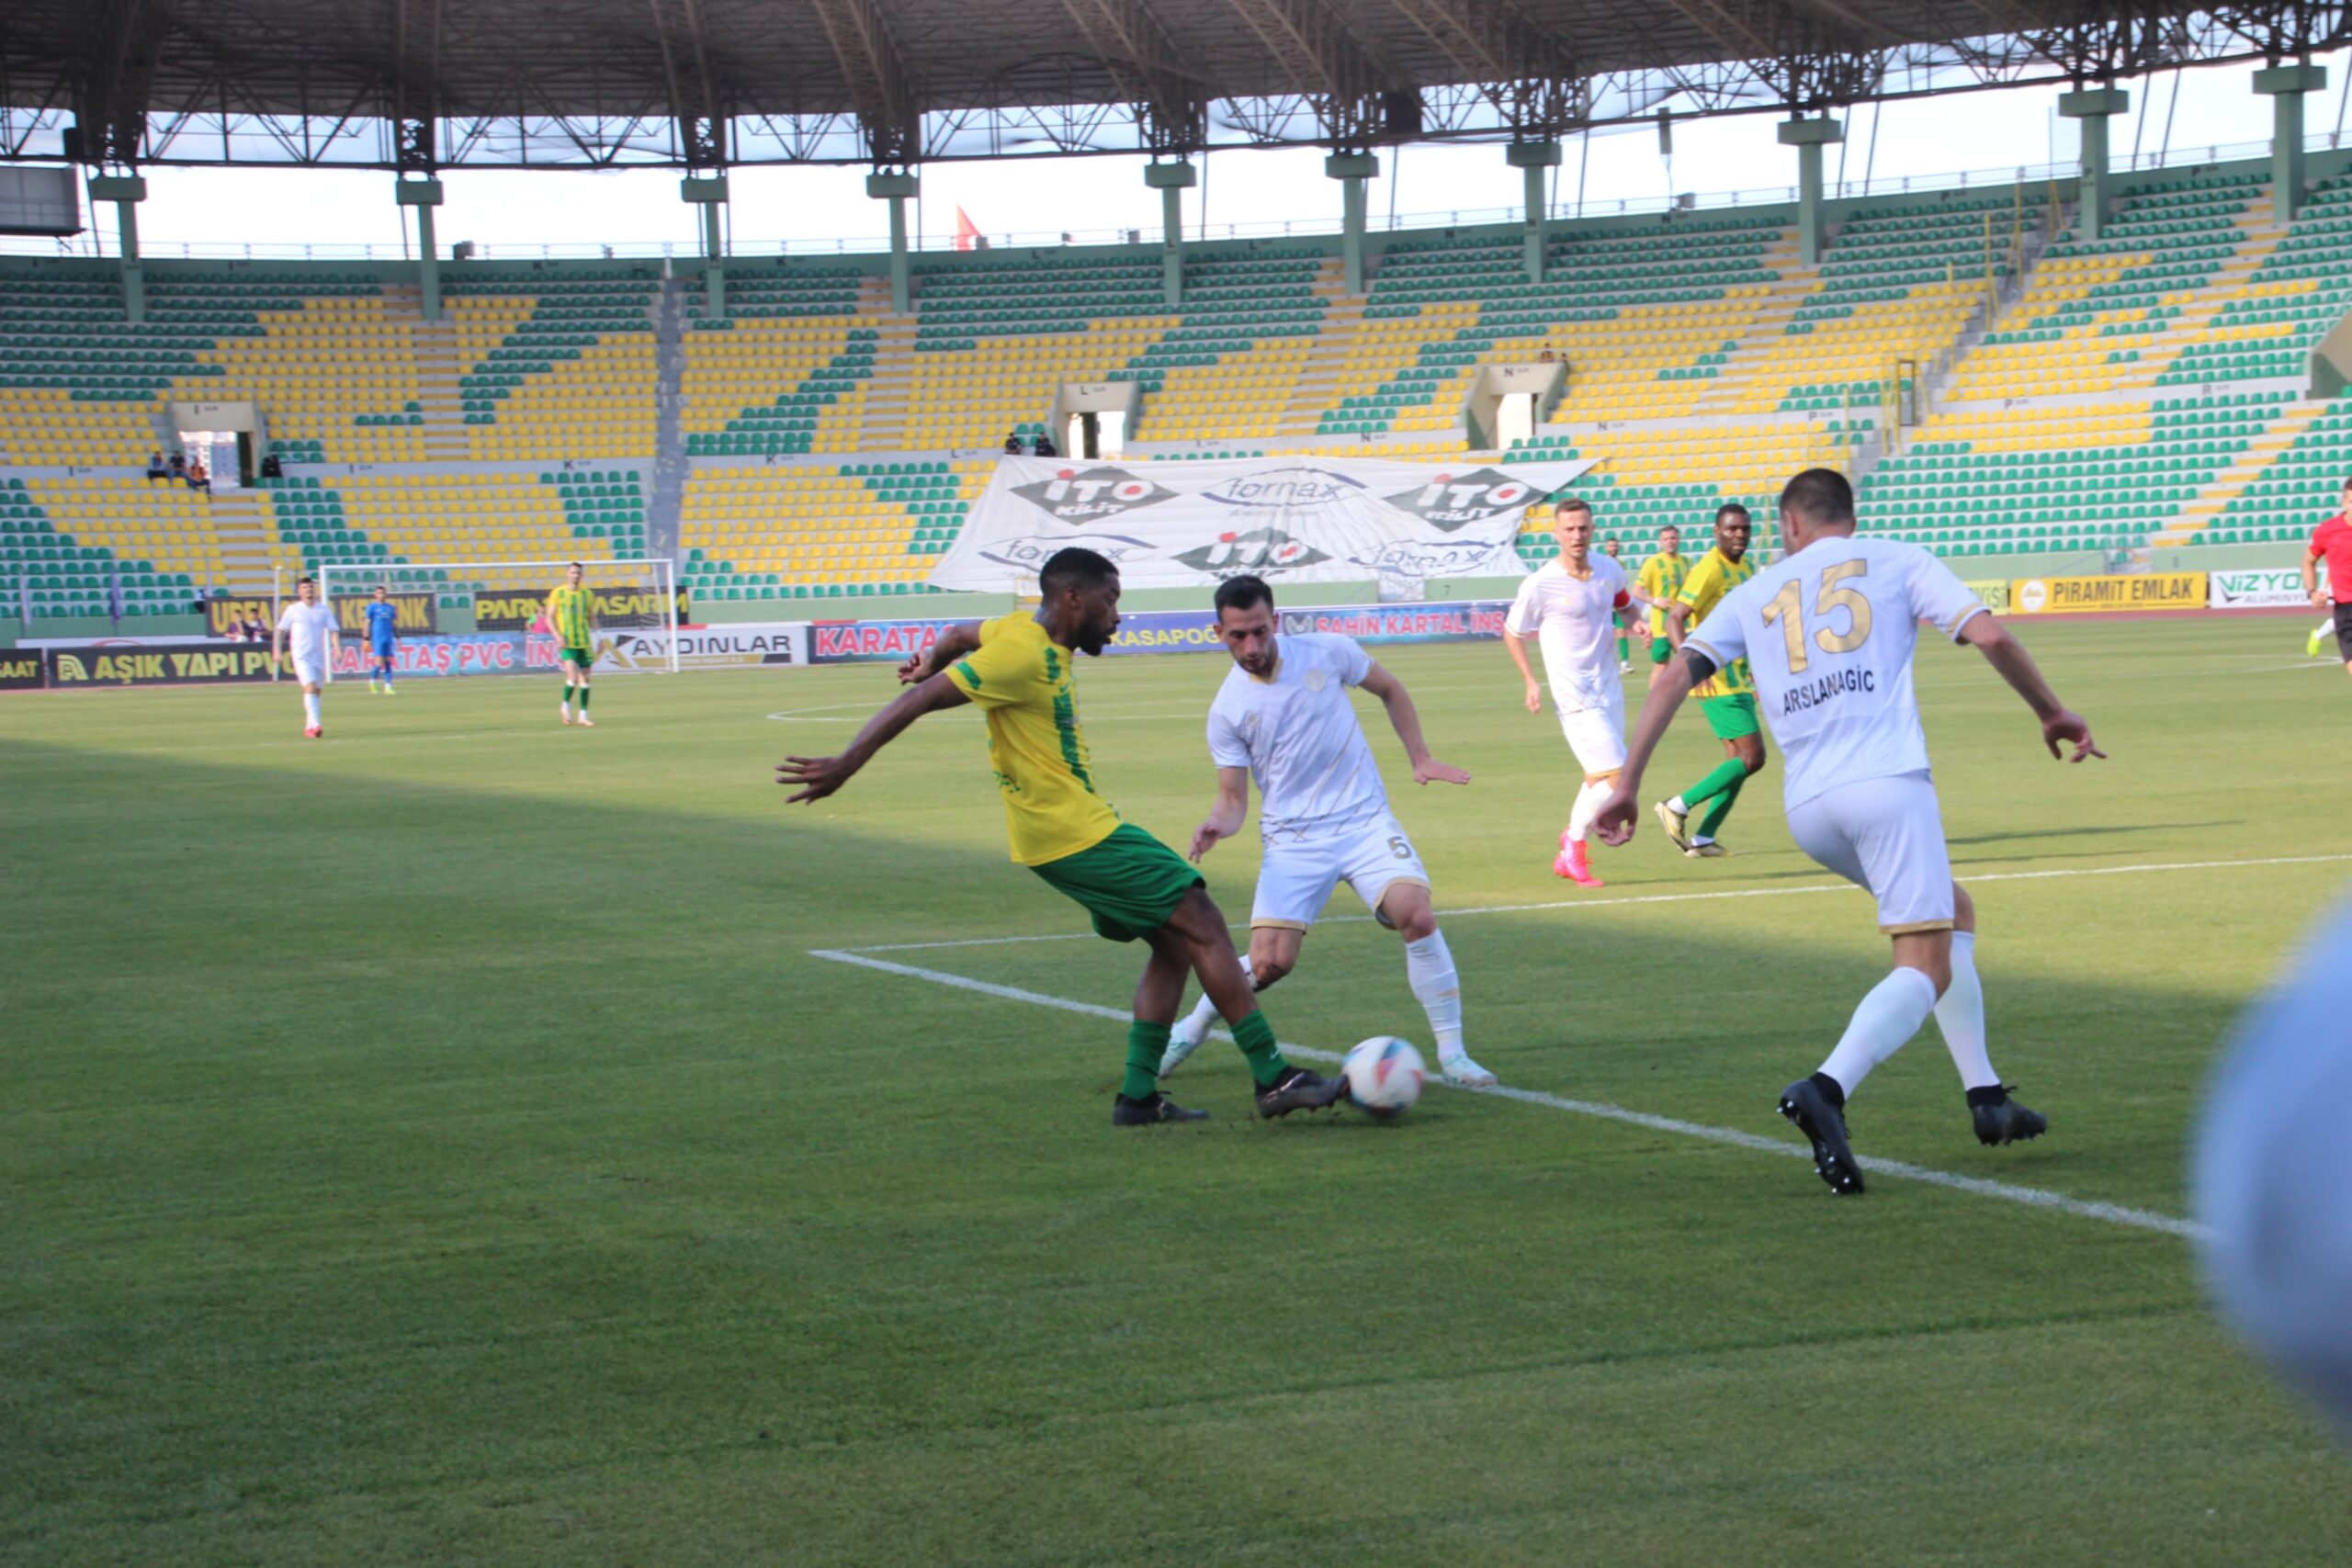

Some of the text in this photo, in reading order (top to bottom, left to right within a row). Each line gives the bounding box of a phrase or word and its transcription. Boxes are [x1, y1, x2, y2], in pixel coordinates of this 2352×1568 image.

[1504, 368, 1514, 378] N
[1080, 386, 1090, 396] L
[2005, 399, 2014, 410] P
[1808, 412, 1817, 422] P
[1598, 422, 1608, 432] N
[1361, 433, 1371, 443] N
[766, 455, 776, 465] K
[951, 449, 960, 459] L
[564, 460, 574, 470] K
[1227, 477, 1340, 498] fornax
[2131, 578, 2195, 601] EMLAK
[1385, 613, 1468, 634] KARTAL
[1760, 558, 1872, 675] 15
[632, 635, 792, 656] AYDINLAR
[815, 624, 956, 656] KARATA
[458, 640, 514, 670] PVC
[94, 653, 166, 684] AŞIK
[170, 651, 239, 677] YAPI
[1387, 835, 1412, 860] 5
